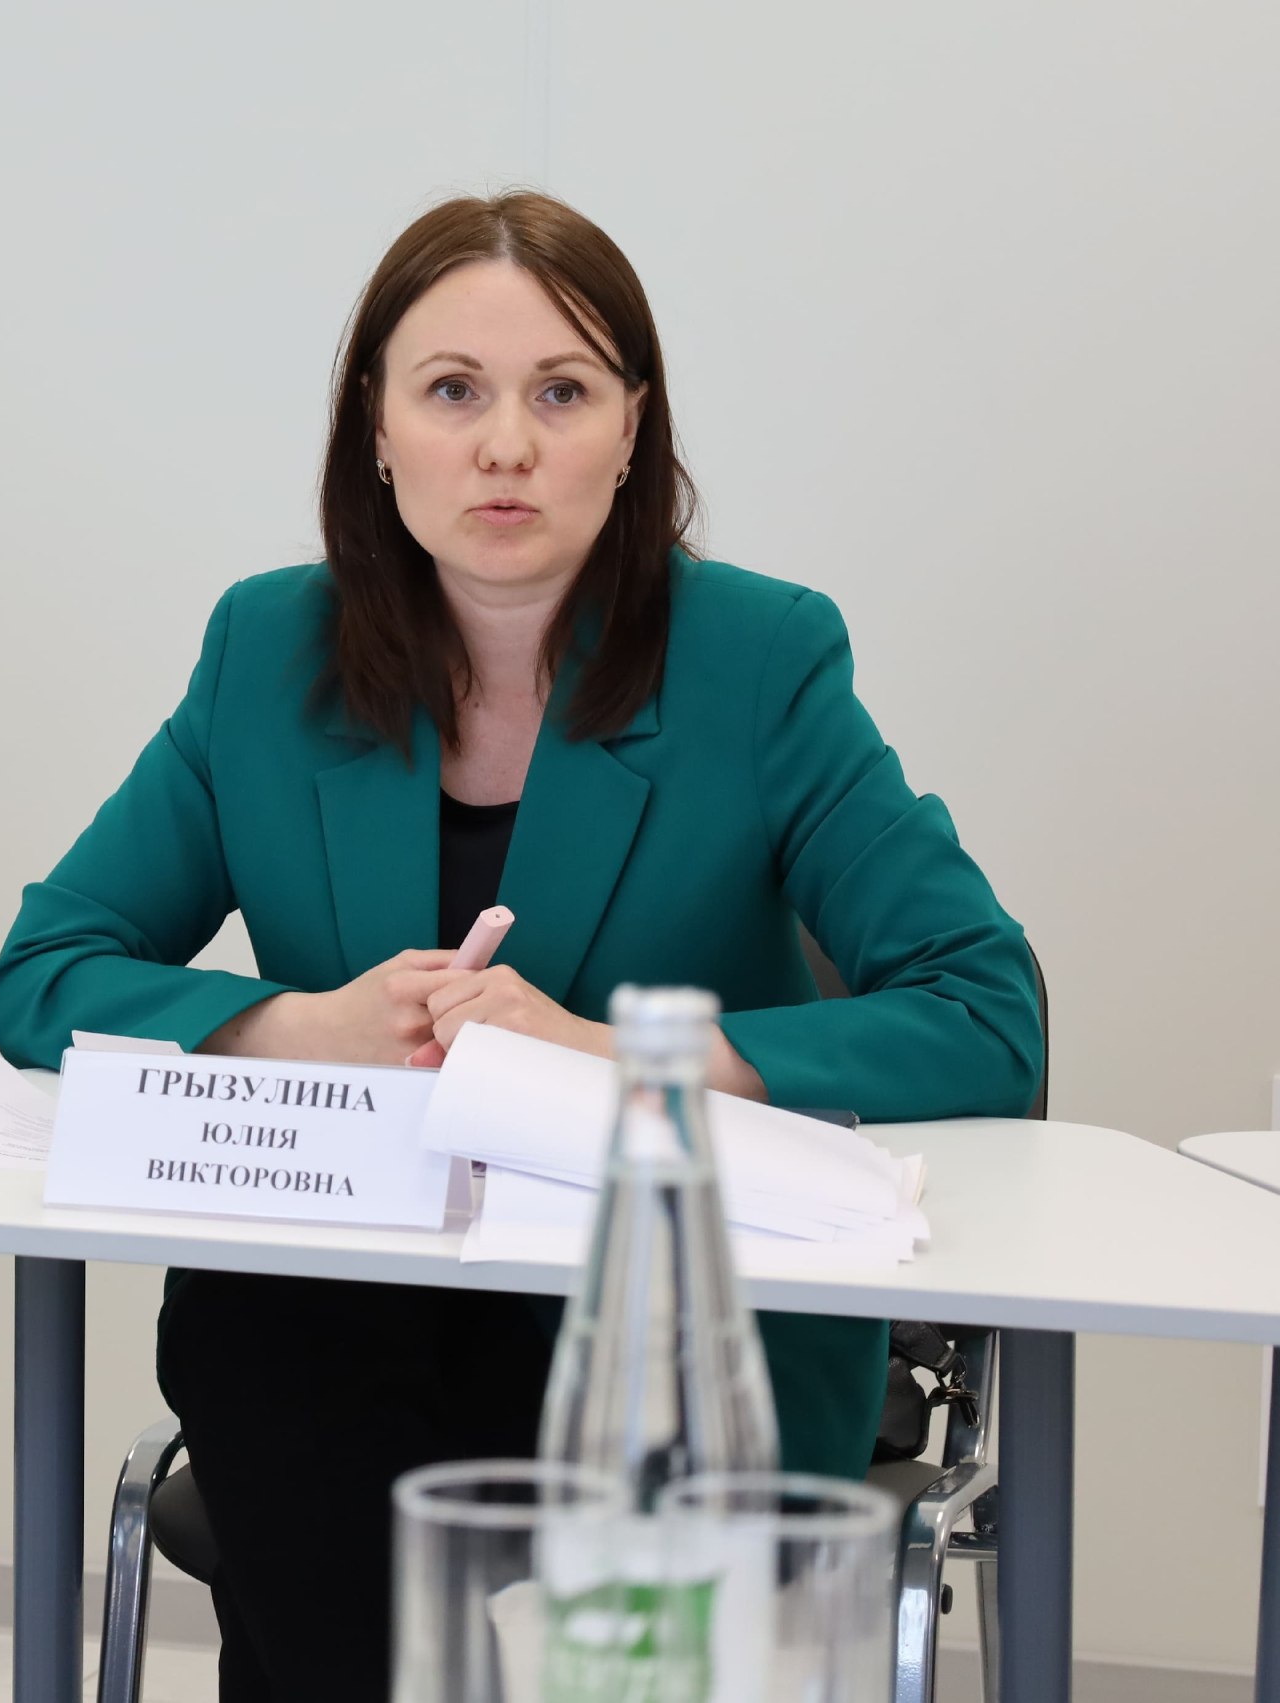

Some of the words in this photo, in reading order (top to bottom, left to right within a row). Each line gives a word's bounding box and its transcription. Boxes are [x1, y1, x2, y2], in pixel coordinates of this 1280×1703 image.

[137, 1067, 377, 1113] ГРЫЗУЛИНА
[200, 1121, 299, 1151] ЮЛИЯ
[146, 1158, 355, 1197] ВИКТОРОВНА
